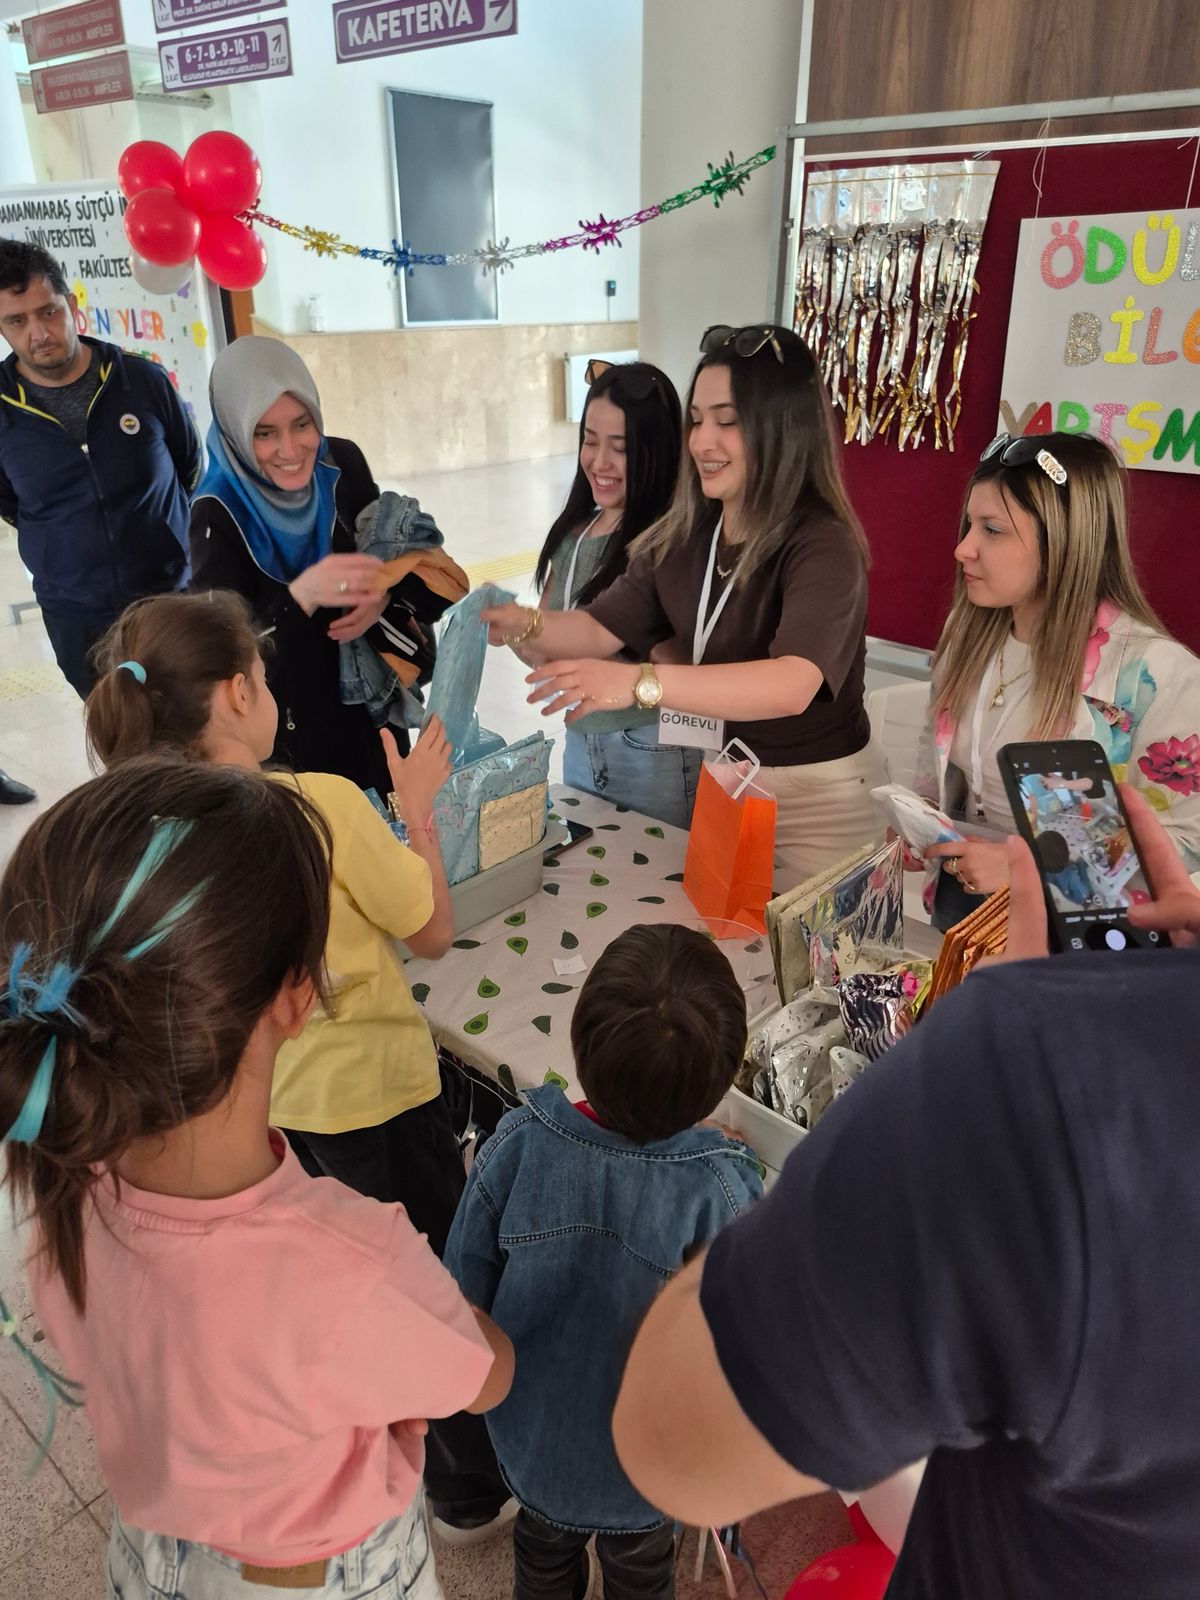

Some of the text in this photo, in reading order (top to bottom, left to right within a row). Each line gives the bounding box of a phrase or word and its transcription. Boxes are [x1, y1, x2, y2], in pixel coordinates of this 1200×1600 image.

[347, 0, 474, 47] KAFETERYA
[185, 35, 260, 63] 6-7-8-9-10-11
[0, 199, 71, 224] AMANMARAŞ
[75, 190, 115, 222] SÜTÇÜ
[25, 224, 97, 249] ÜNİVERSİTESİ
[661, 711, 717, 732] GÖREVLİ
